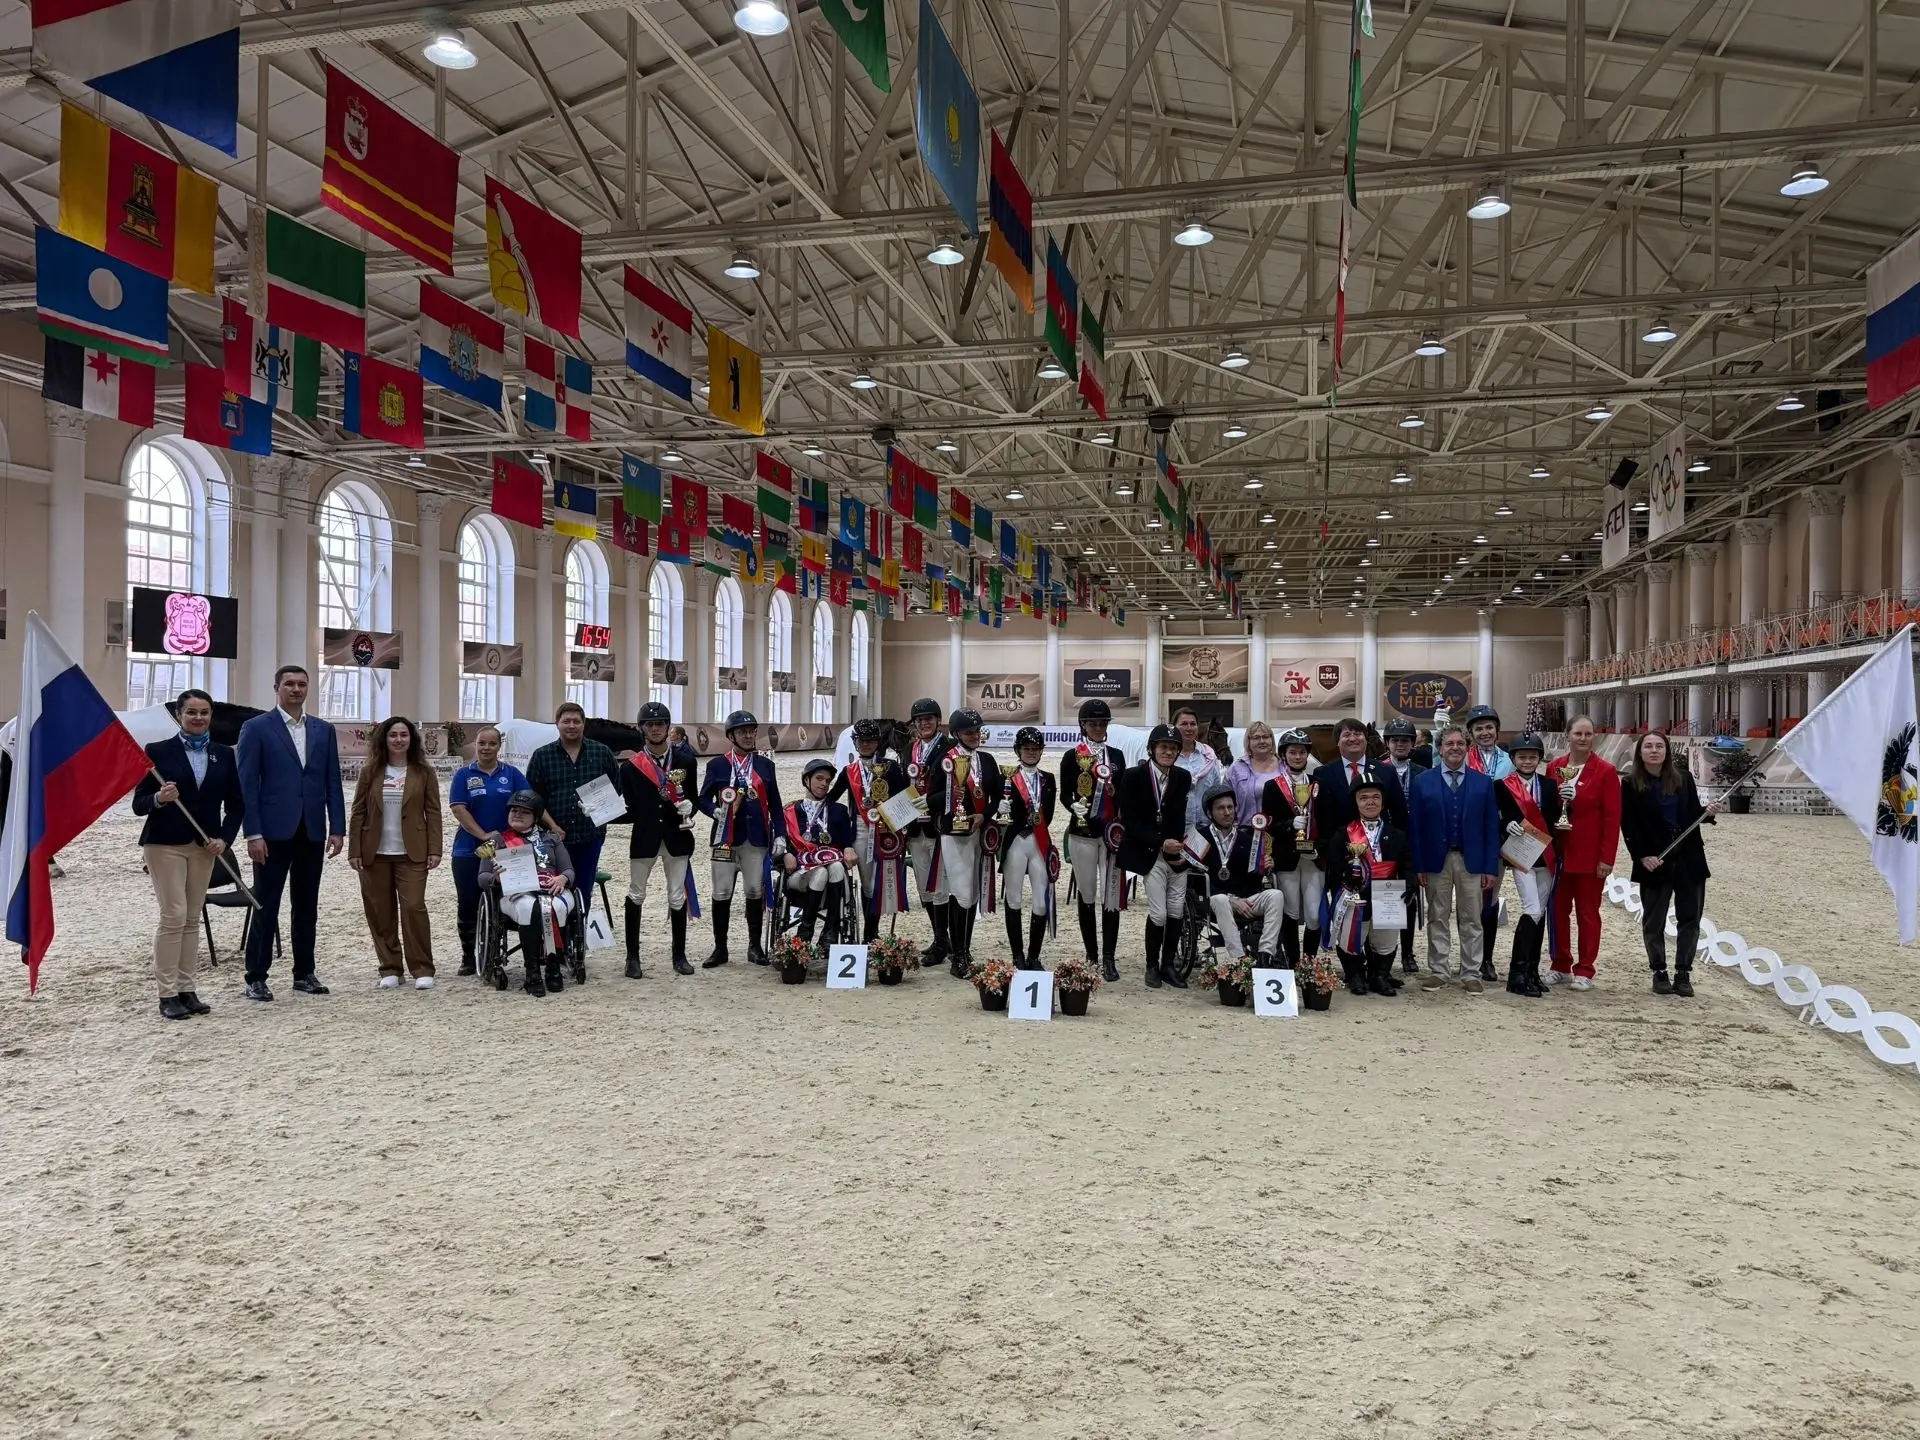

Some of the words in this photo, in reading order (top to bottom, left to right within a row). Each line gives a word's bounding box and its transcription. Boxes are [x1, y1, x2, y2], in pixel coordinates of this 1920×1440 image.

[1605, 500, 1625, 540] FEI
[981, 684, 1025, 699] ALIR
[1400, 696, 1455, 708] MEDA
[982, 700, 1023, 711] EMBRYOS
[590, 920, 604, 940] 1
[838, 953, 857, 978] 2
[1025, 981, 1039, 1009] 1
[1265, 979, 1285, 1005] 3
